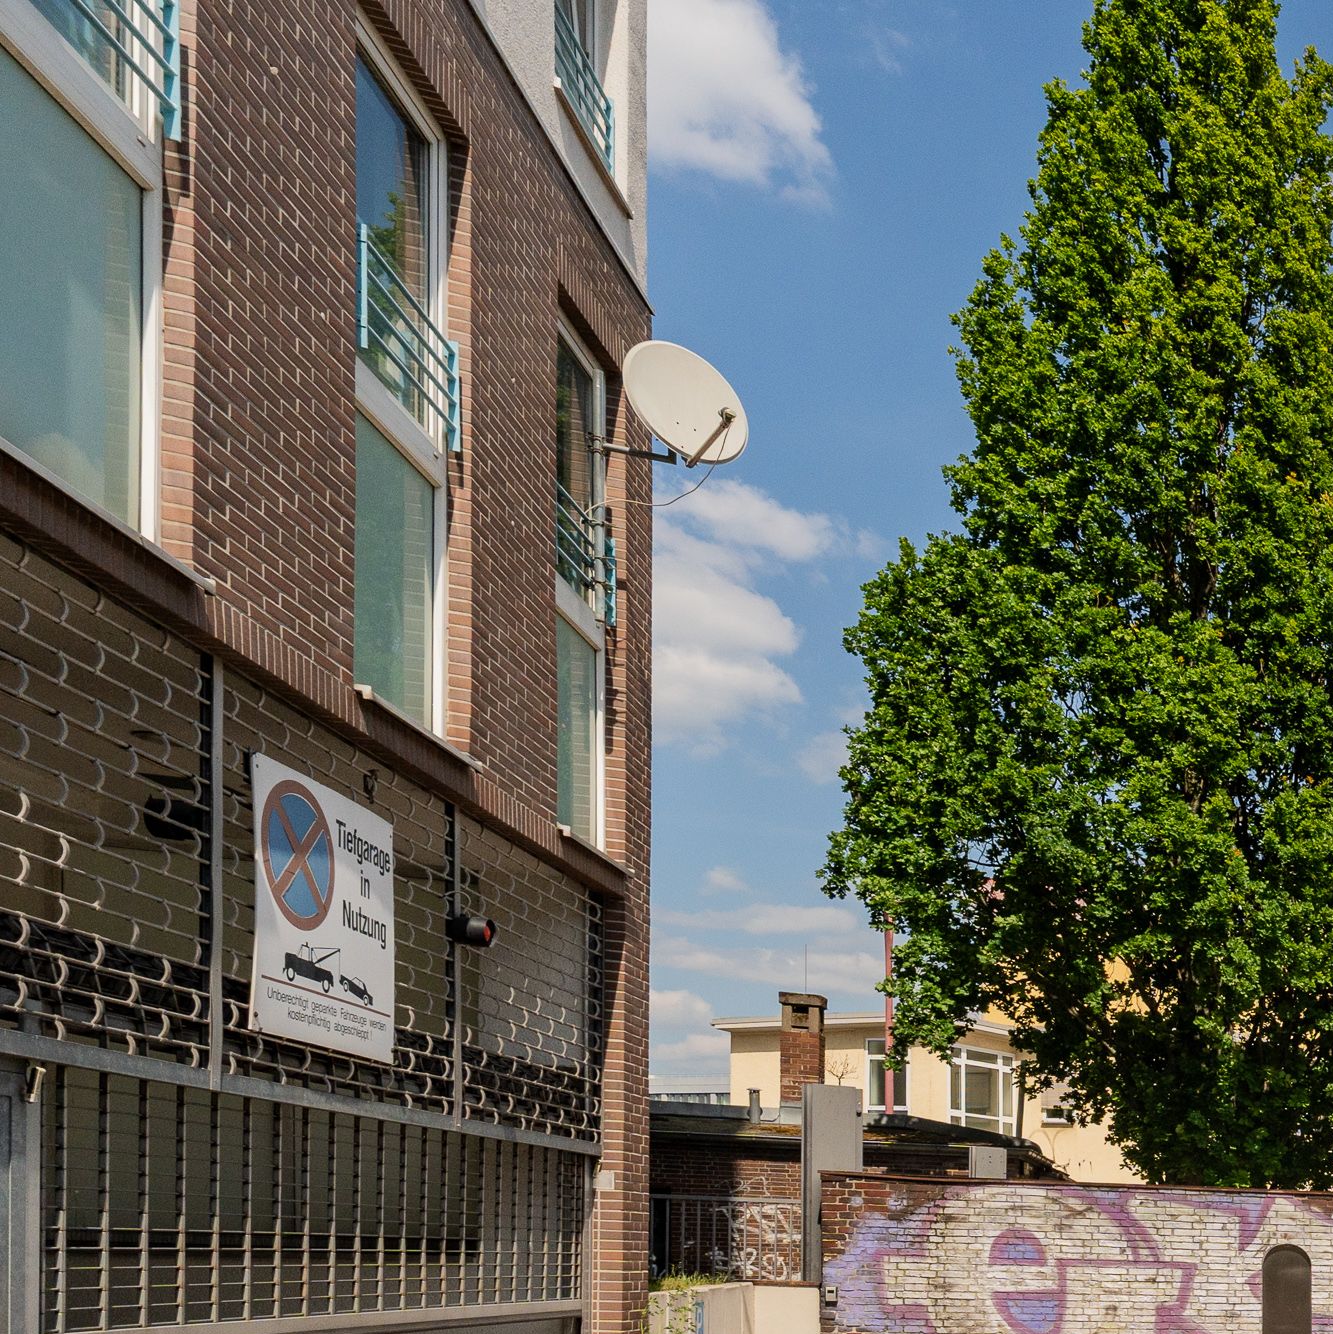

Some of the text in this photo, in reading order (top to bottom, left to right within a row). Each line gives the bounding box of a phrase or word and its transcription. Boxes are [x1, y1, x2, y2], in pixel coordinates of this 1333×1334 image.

[336, 819, 391, 876] Tiefgarage
[360, 869, 371, 900] in
[342, 899, 387, 950] Nutzung
[266, 986, 387, 1032] Unberechtigt geparkte Fahrzeuge werden
[287, 1007, 331, 1032] kostenpflichtig
[333, 1021, 369, 1042] abgeschleppt
